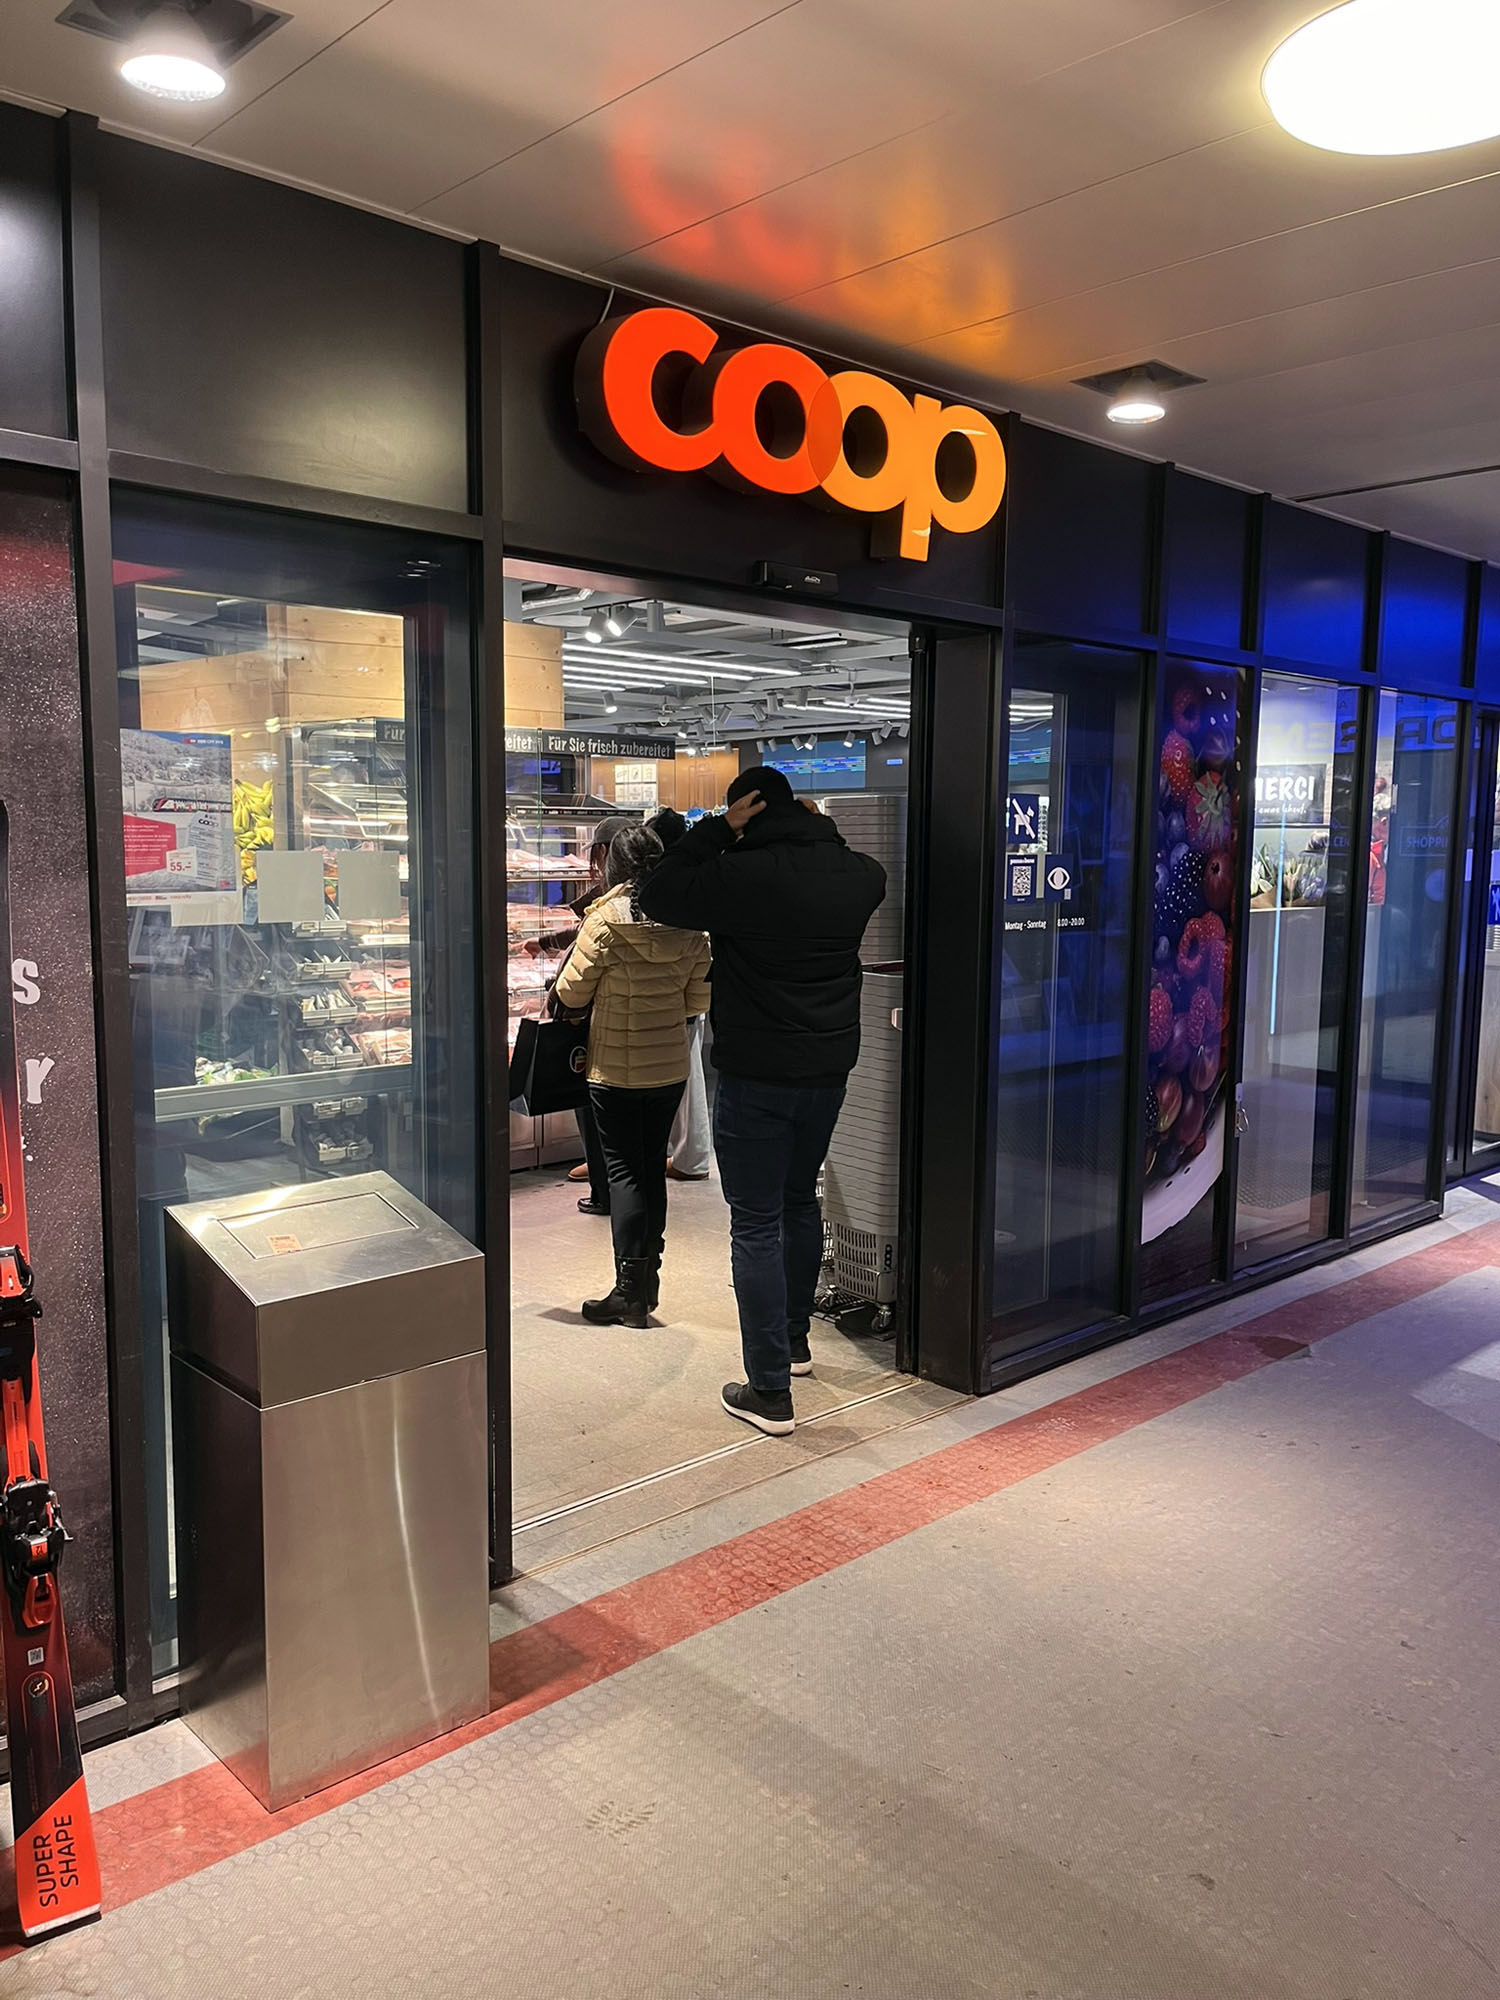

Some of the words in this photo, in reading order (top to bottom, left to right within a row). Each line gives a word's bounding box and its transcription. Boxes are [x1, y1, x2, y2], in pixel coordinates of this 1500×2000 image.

[602, 306, 1007, 562] coop
[384, 724, 405, 741] Für
[504, 733, 532, 750] eitet
[548, 735, 567, 751] Für
[569, 737, 586, 753] Sie
[587, 738, 618, 755] frisch
[620, 741, 671, 758] zubereitet
[1005, 922, 1024, 931] Montag
[1027, 920, 1047, 930] Sonntag
[53, 1814, 79, 1888] SHAPE
[33, 1833, 58, 1908] SUPER
